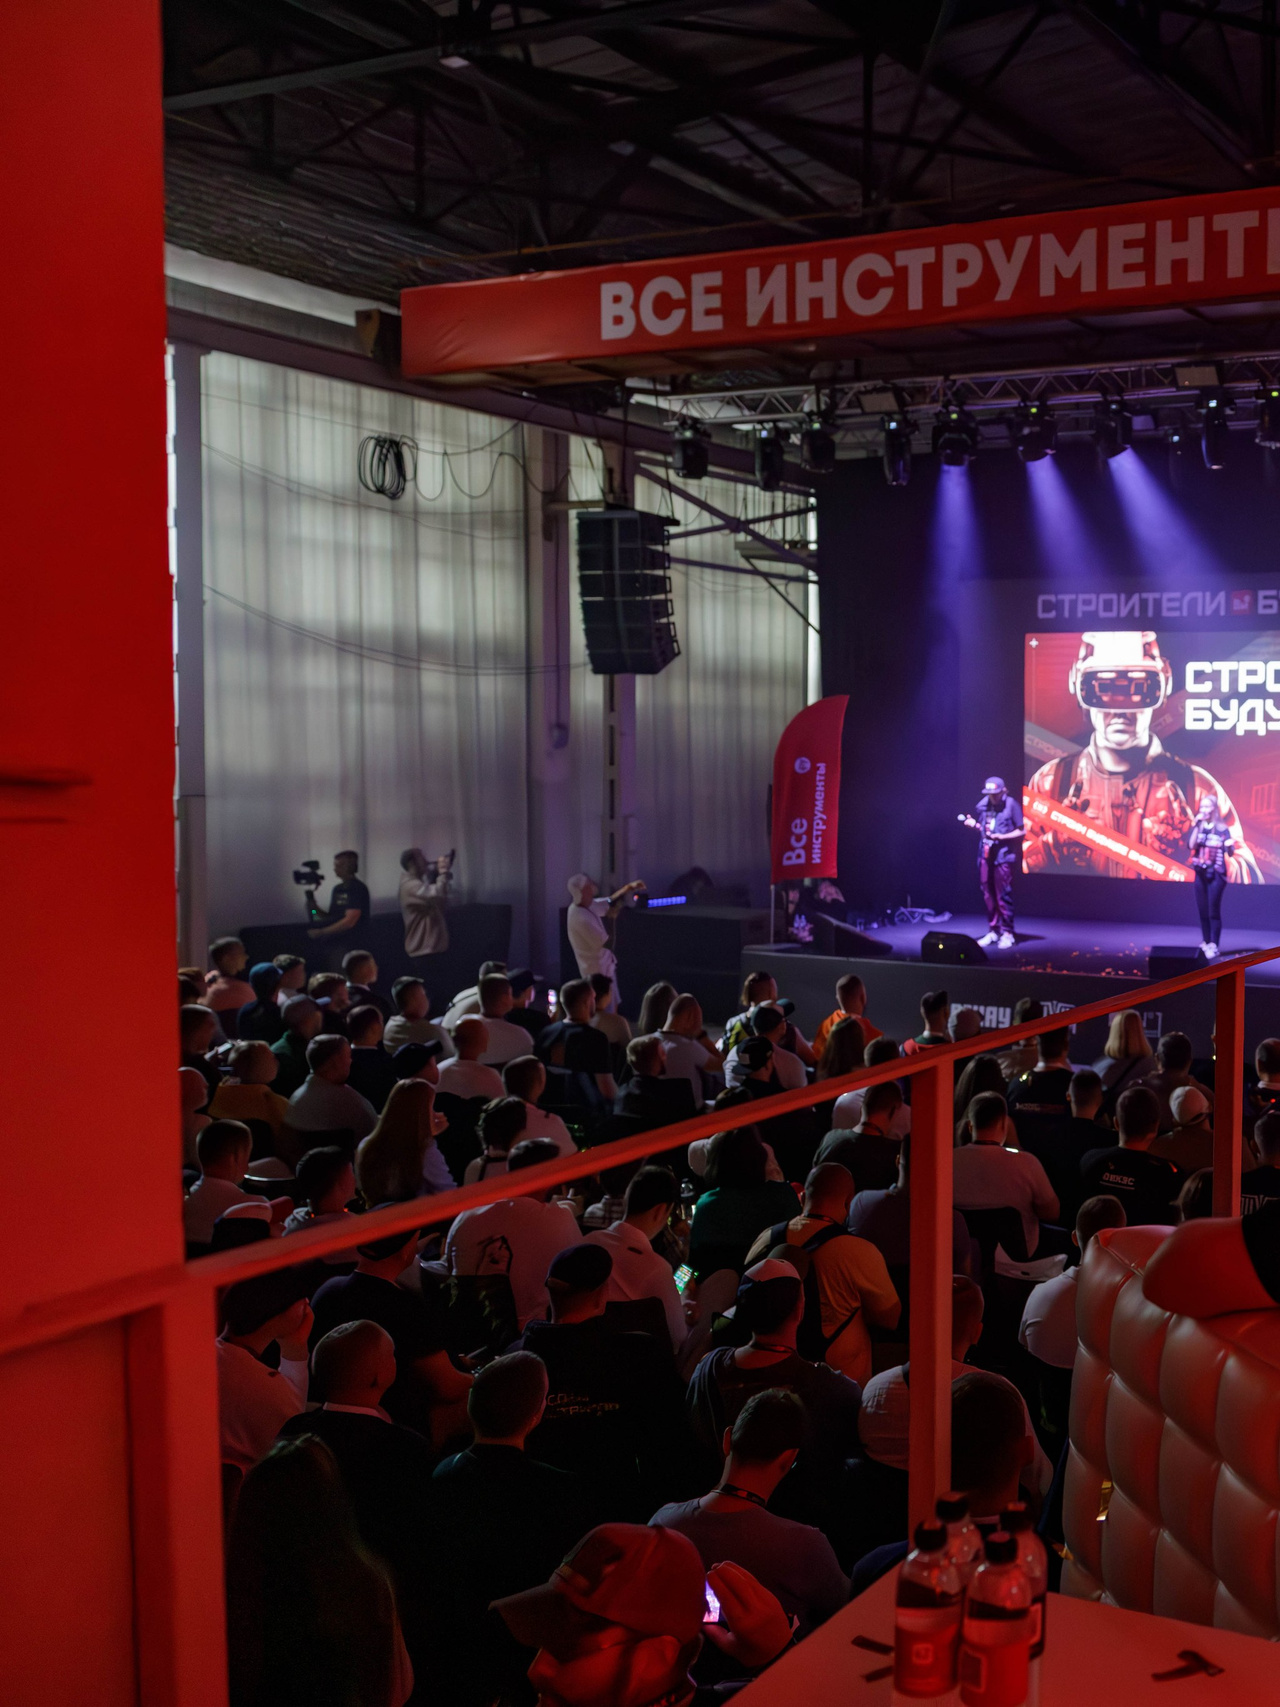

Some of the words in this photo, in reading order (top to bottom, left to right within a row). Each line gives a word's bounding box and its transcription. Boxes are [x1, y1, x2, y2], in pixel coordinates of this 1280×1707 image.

[600, 271, 724, 341] ВСЕ
[1037, 591, 1226, 618] СТРОИТЕЛИ
[811, 763, 827, 863] инструменты
[783, 819, 808, 866] Все
